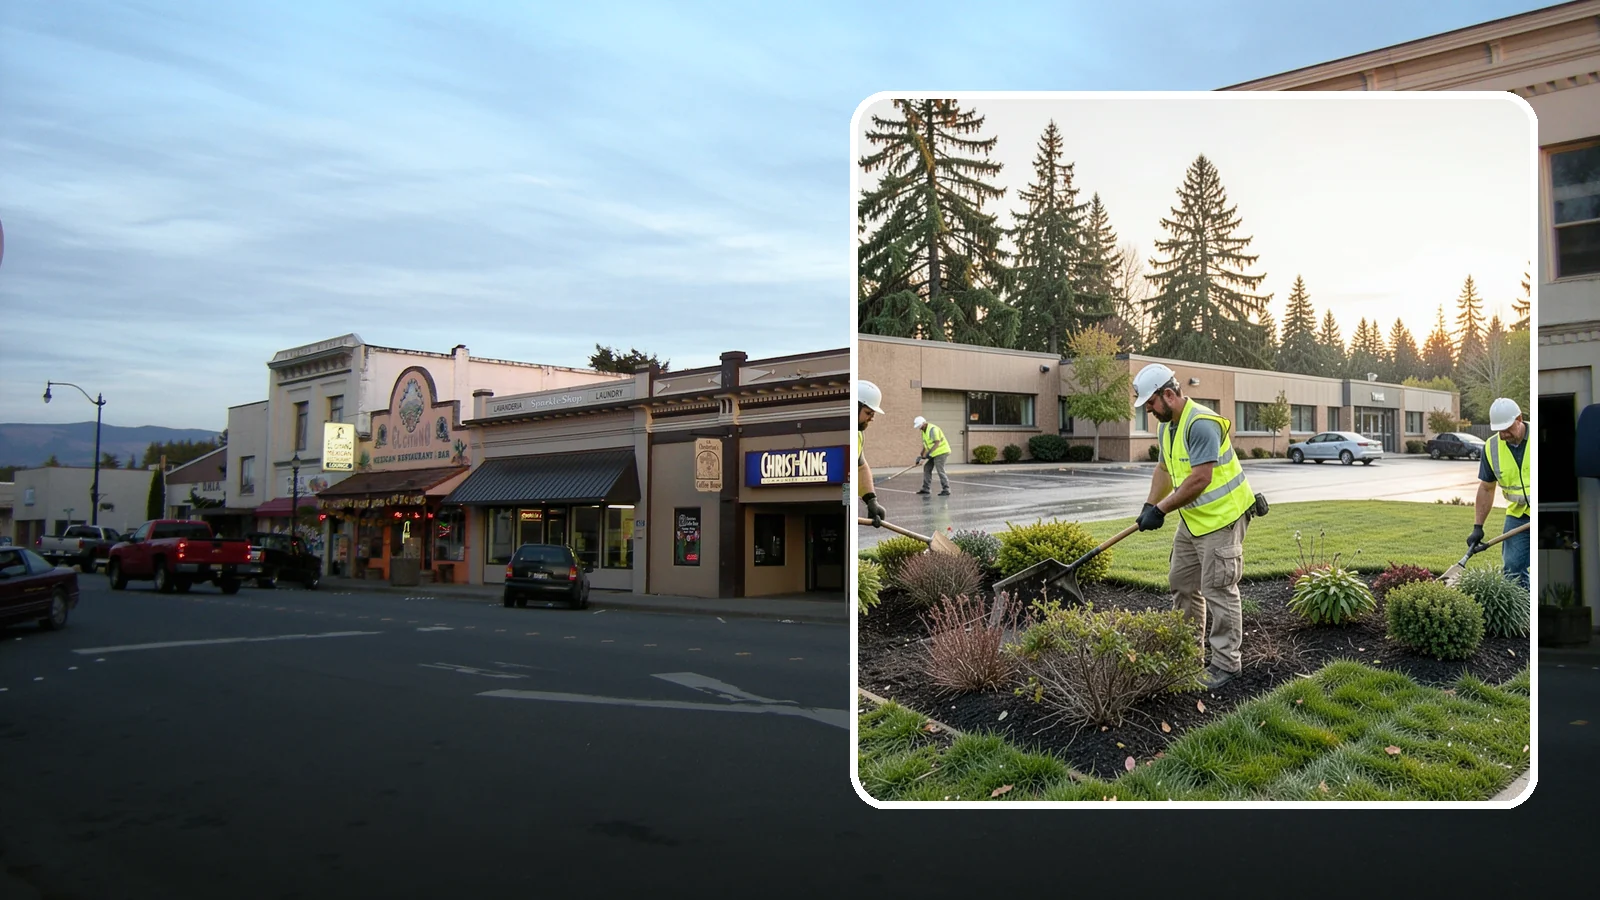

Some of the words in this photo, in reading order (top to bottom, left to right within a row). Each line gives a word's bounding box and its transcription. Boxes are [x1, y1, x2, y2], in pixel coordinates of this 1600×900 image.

[596, 389, 623, 400] LAUNDRY
[493, 402, 522, 412] LAVANDERIA
[531, 397, 561, 409] Sparkle
[562, 394, 582, 404] Shop
[373, 456, 396, 465] MEXICAN
[398, 452, 434, 462] RESTAURANT
[438, 450, 450, 460] BAR
[760, 452, 797, 478] CHRIST
[799, 450, 827, 476] KING
[710, 481, 721, 489] House
